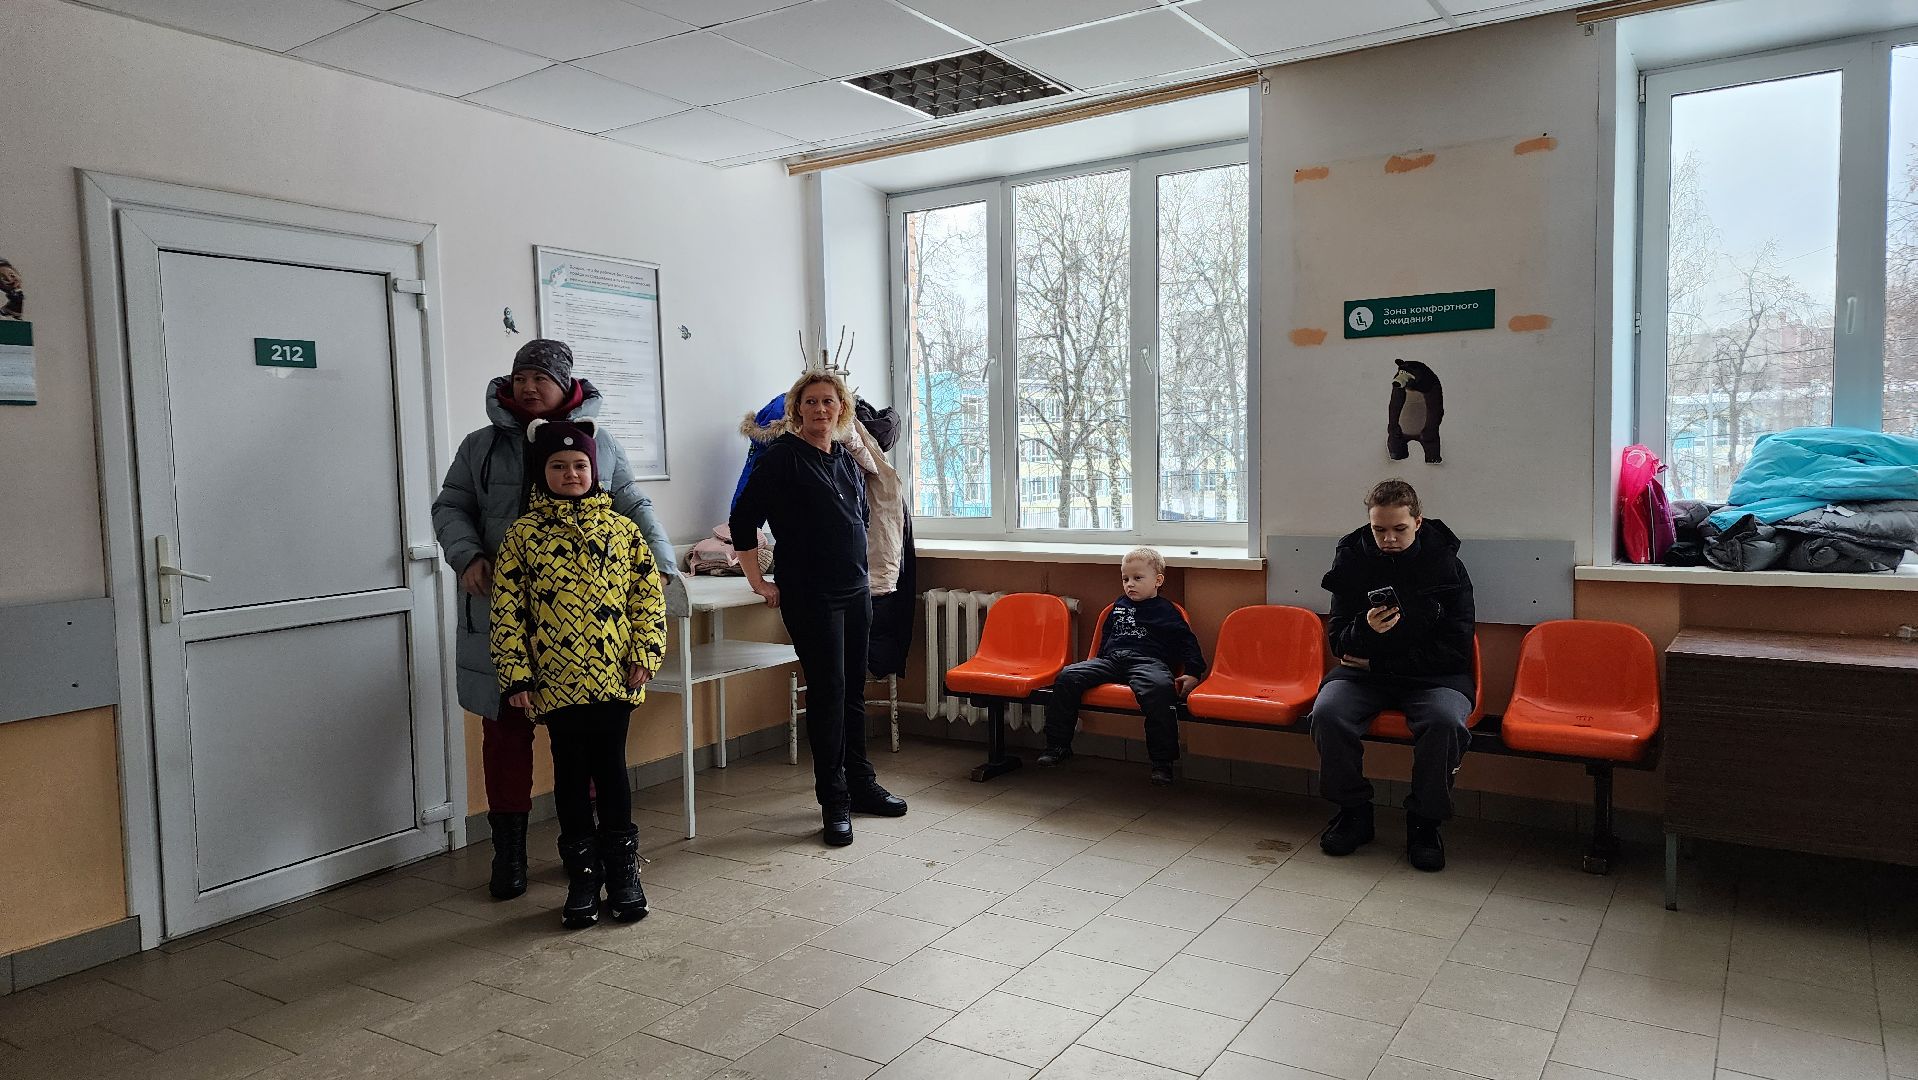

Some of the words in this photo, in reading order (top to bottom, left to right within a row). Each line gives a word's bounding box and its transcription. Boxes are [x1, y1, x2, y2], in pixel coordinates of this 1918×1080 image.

[1383, 308, 1407, 316] Зона
[1410, 302, 1479, 315] комфортного
[1383, 315, 1433, 326] ожидания
[271, 344, 304, 362] 212
